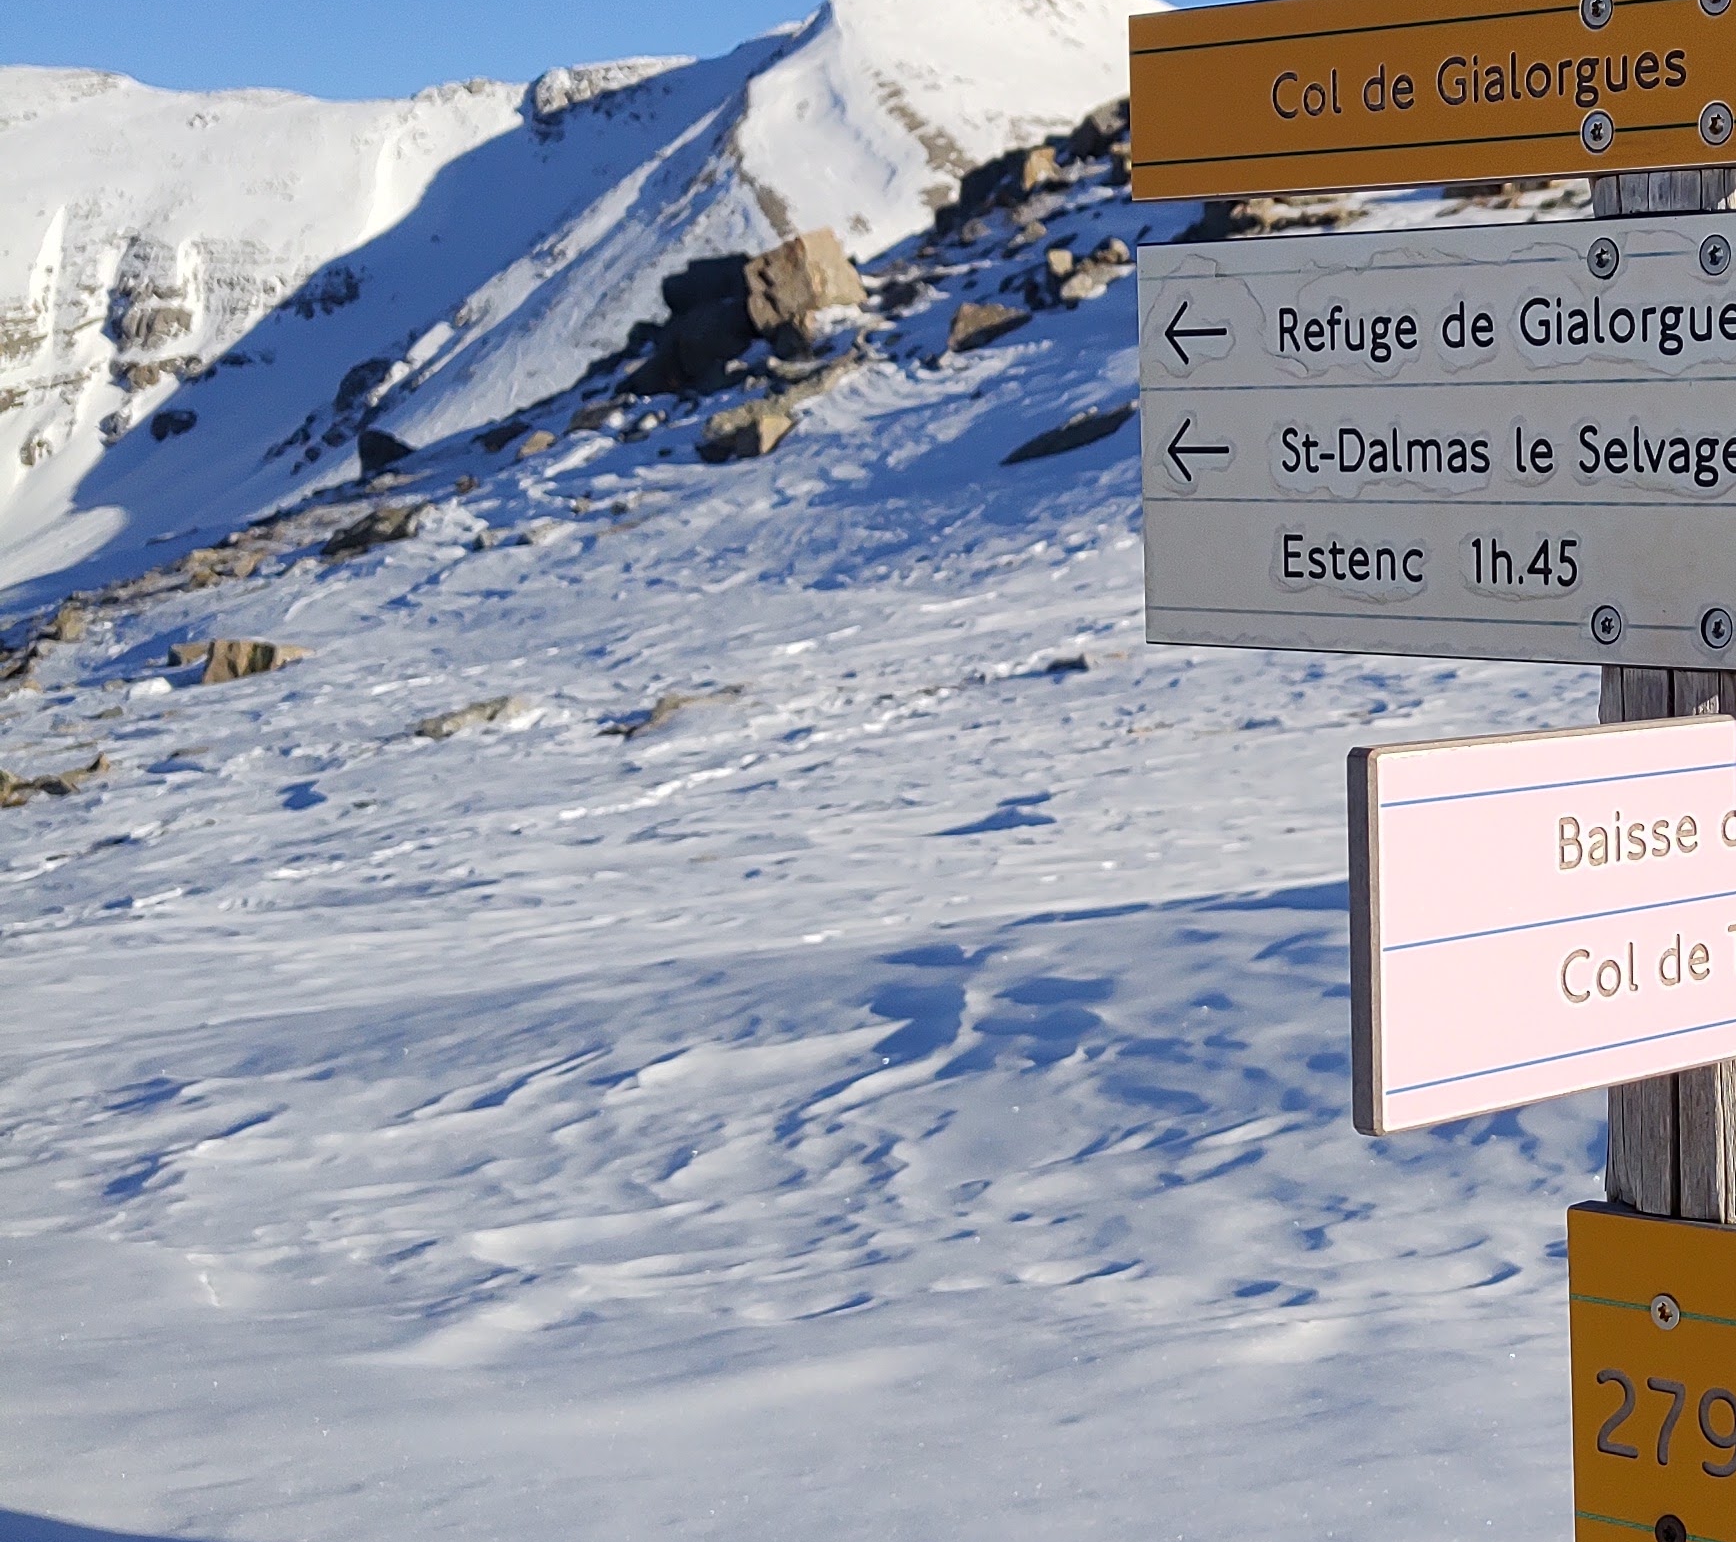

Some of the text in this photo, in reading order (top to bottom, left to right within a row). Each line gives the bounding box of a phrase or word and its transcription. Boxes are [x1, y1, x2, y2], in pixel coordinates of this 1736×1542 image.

[1270, 67, 1342, 120] Col
[1362, 63, 1416, 112] de
[1436, 46, 1688, 107] Gialorgues
[1277, 306, 1419, 363] Refuge
[1442, 300, 1495, 348] de
[1280, 426, 1491, 474] St-Dalmas
[1515, 424, 1555, 473] le
[1281, 535, 1578, 587] Estenc 1h.45
[1557, 810, 1699, 870] Baisse
[1561, 942, 1639, 1004] Col
[1657, 933, 1711, 987] de
